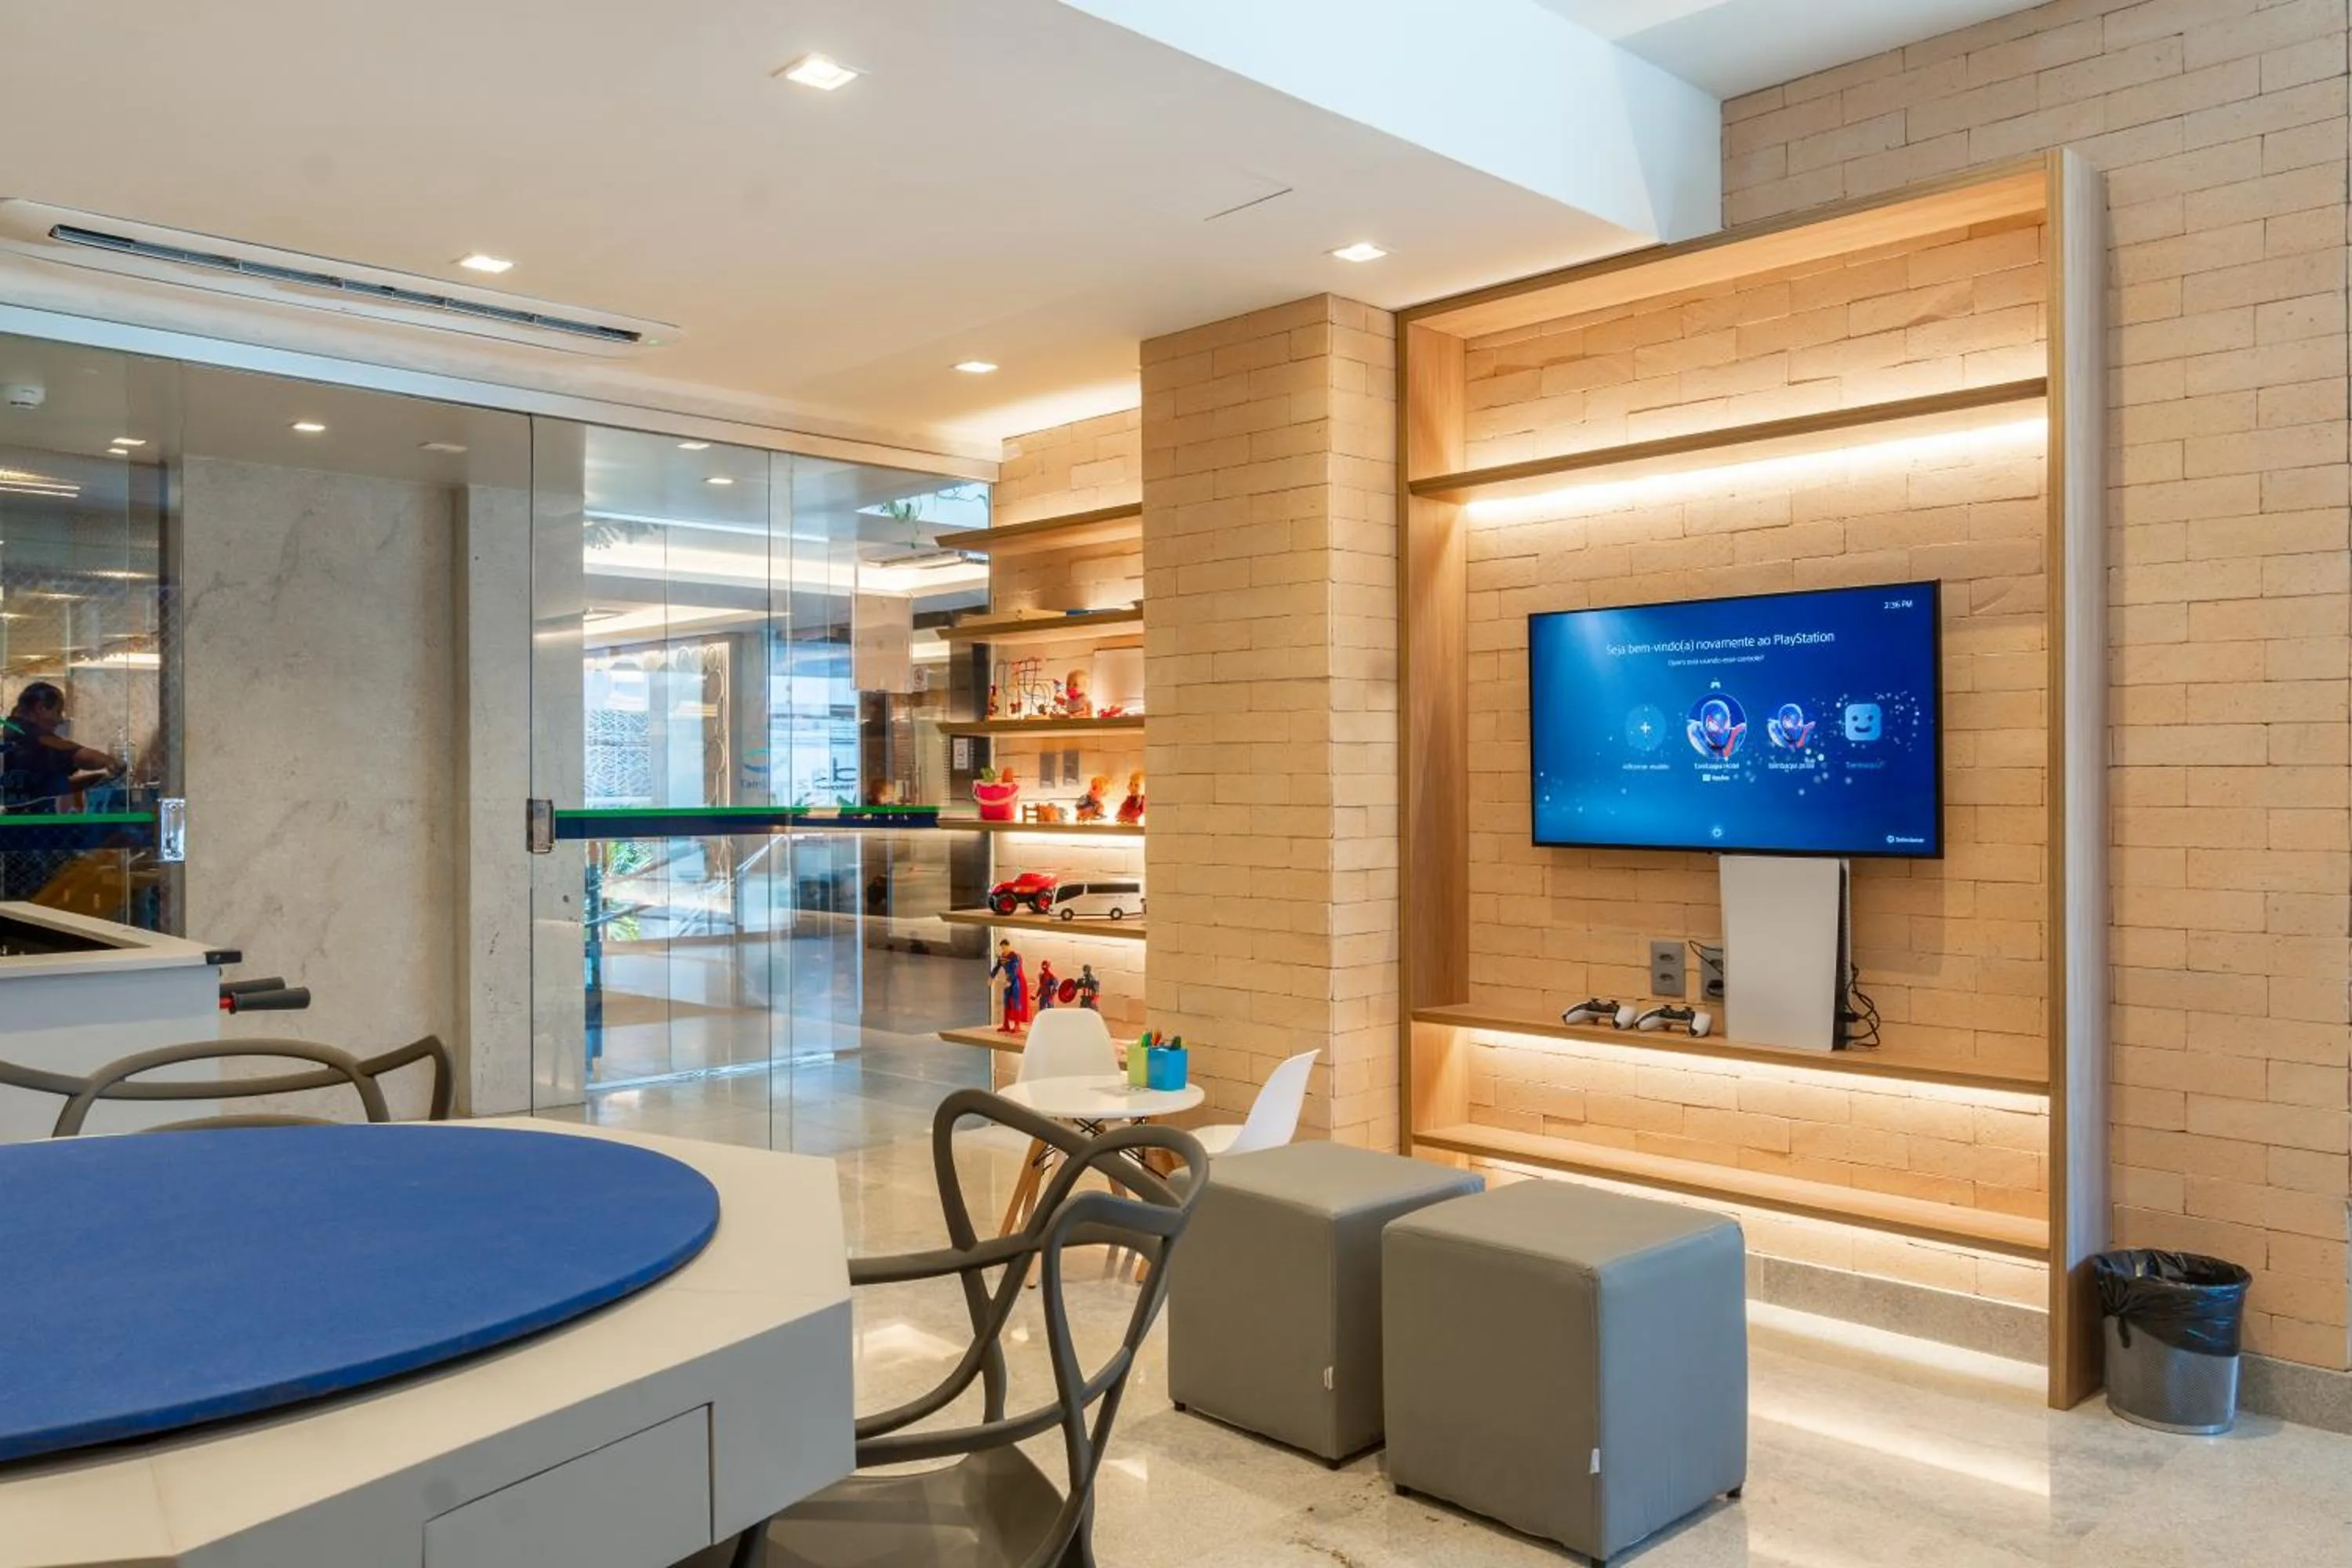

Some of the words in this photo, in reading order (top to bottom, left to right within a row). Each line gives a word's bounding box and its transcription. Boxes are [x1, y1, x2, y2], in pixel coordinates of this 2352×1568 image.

[1901, 599, 1913, 608] PM
[1606, 644, 1625, 656] Seja
[1628, 639, 1694, 655] bem-vindo(a)
[1696, 637, 1756, 650] novamente
[1757, 636, 1771, 646] ao
[1773, 631, 1835, 646] PlayStation
